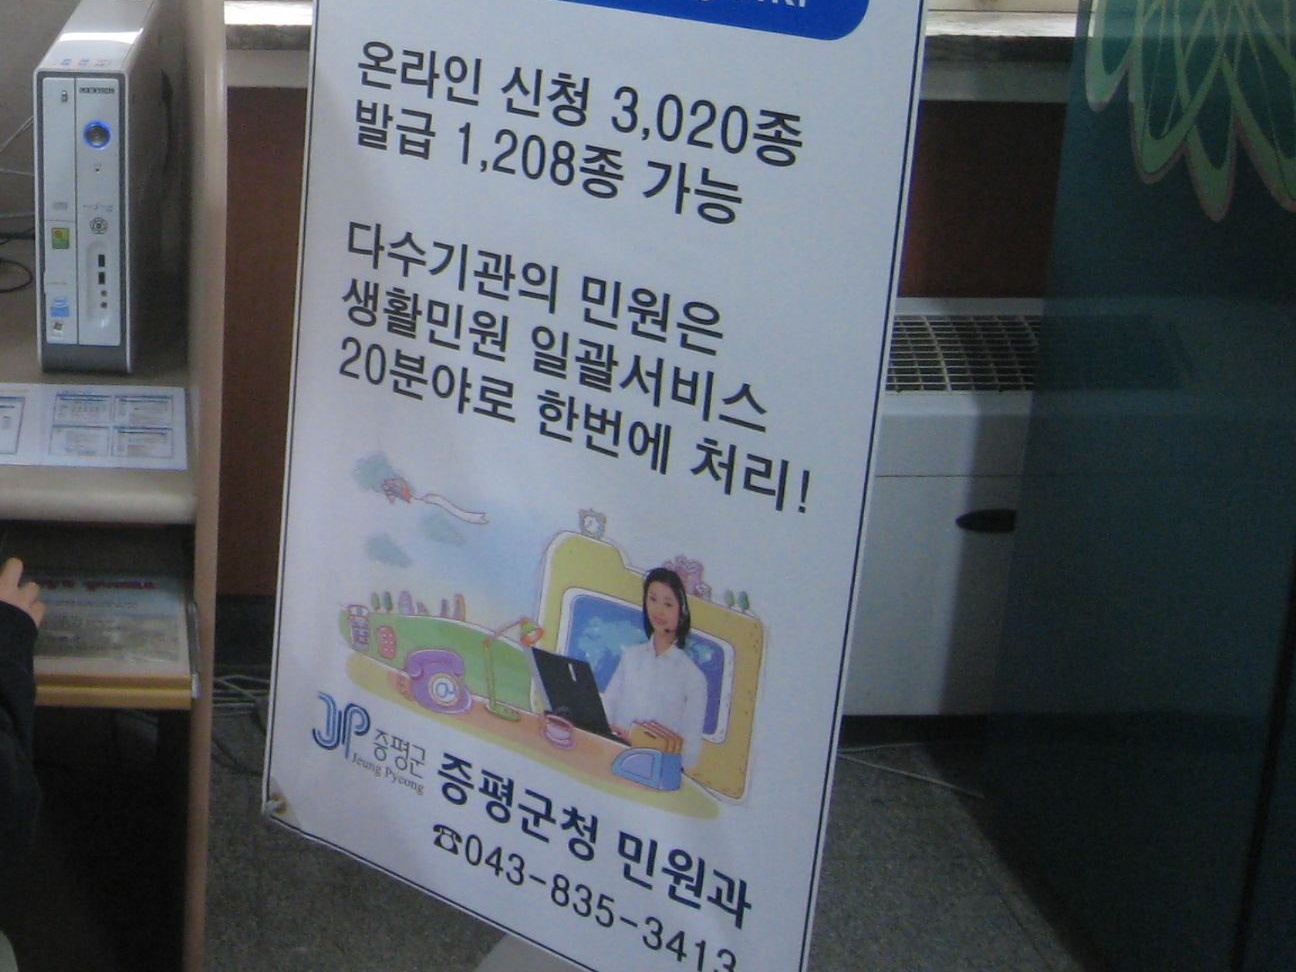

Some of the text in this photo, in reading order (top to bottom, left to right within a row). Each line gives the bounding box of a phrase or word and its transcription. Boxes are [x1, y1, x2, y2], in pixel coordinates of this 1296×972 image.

[355, 99, 743, 225] 발급 1,208종 가능
[357, 40, 804, 168] 온라인 신청 3,020종
[348, 221, 724, 357] 다수기관의 민원은
[342, 277, 768, 434] 생활민원 일괄서비스
[339, 336, 811, 514] 20분야로 한번에 처리!
[352, 752, 424, 796] Jeung Pyeong
[373, 729, 426, 780] 증평군
[437, 750, 752, 929] 증평군청 민원과
